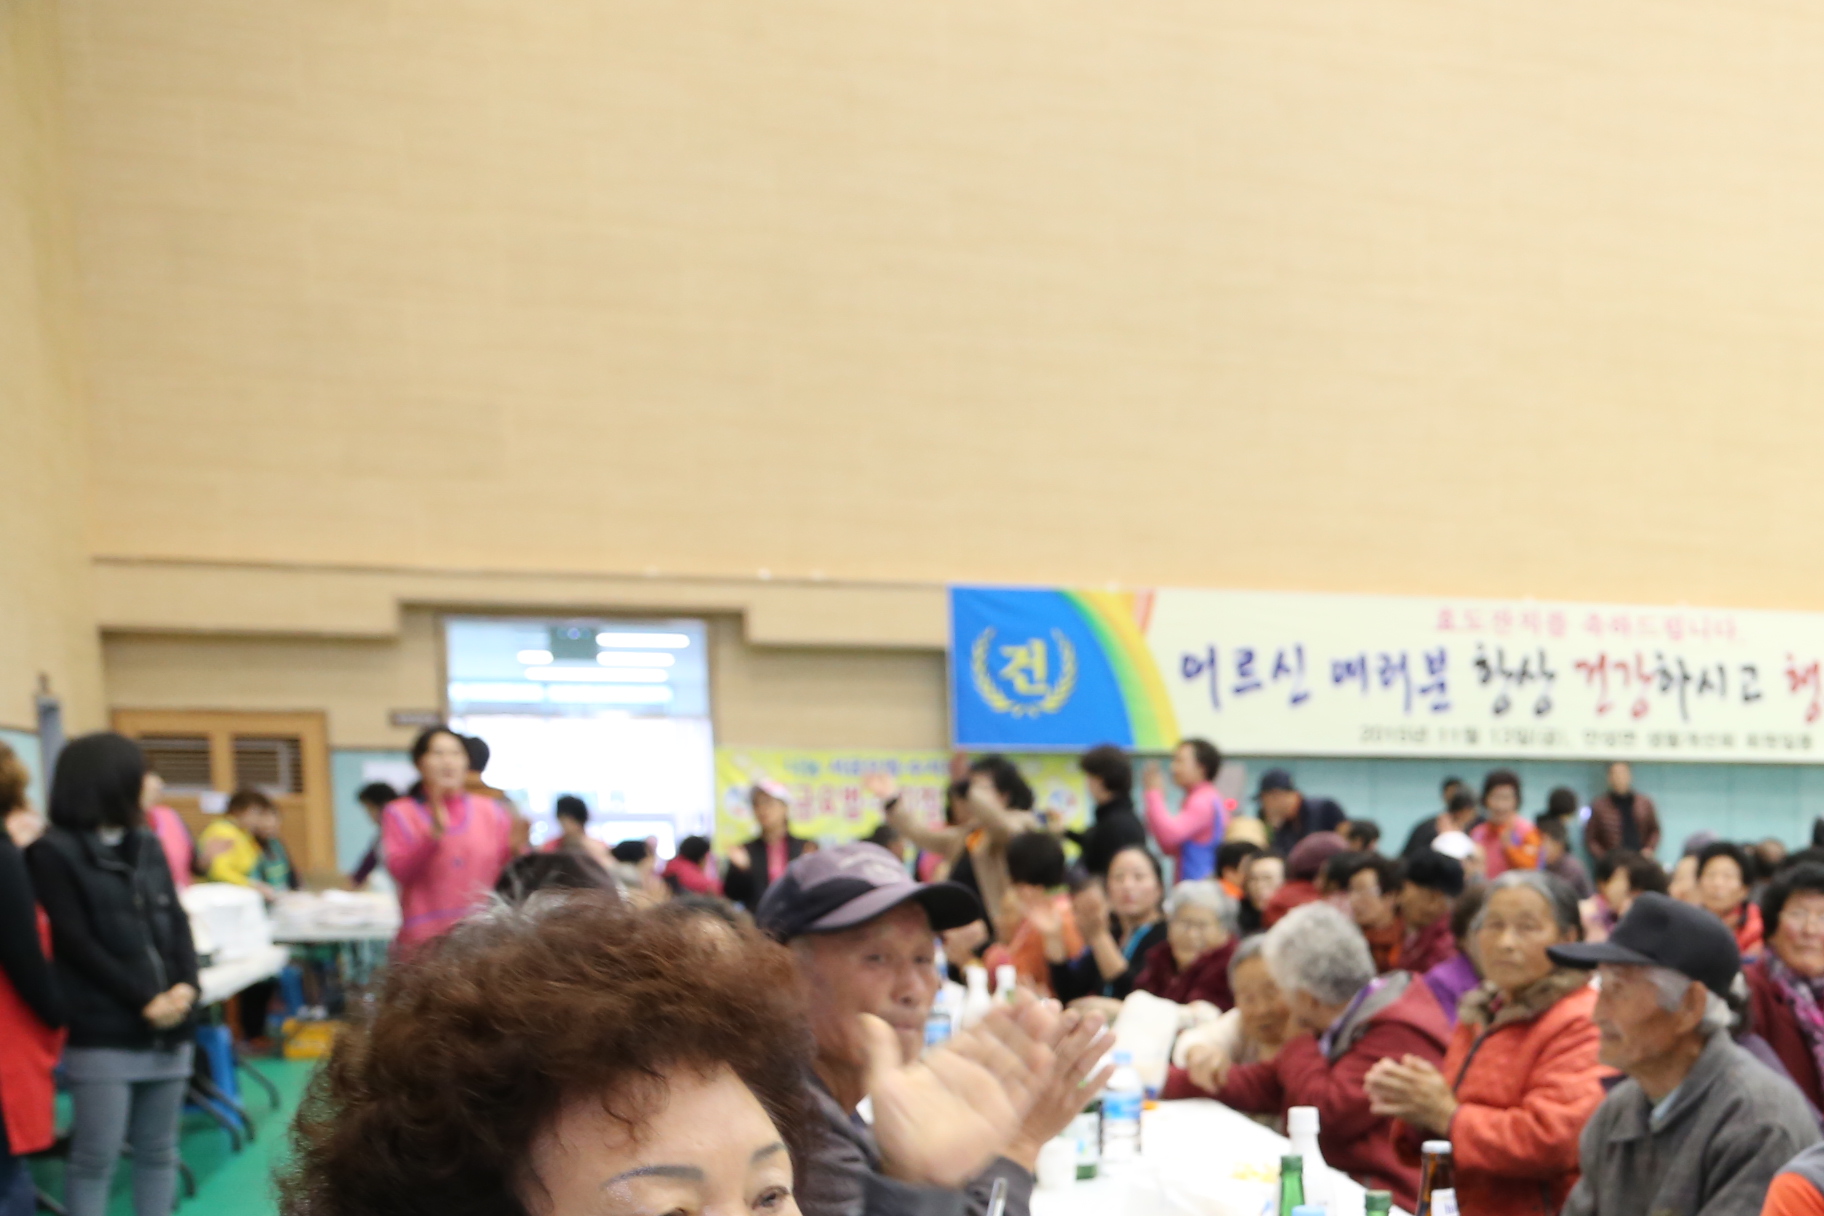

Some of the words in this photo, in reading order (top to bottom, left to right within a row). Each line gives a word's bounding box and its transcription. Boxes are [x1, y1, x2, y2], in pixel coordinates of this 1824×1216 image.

[1180, 643, 1314, 711] 어르신
[1332, 646, 1453, 714] 여러분
[1474, 641, 1557, 718] 항상
[1575, 649, 1765, 723] 건강하시고
